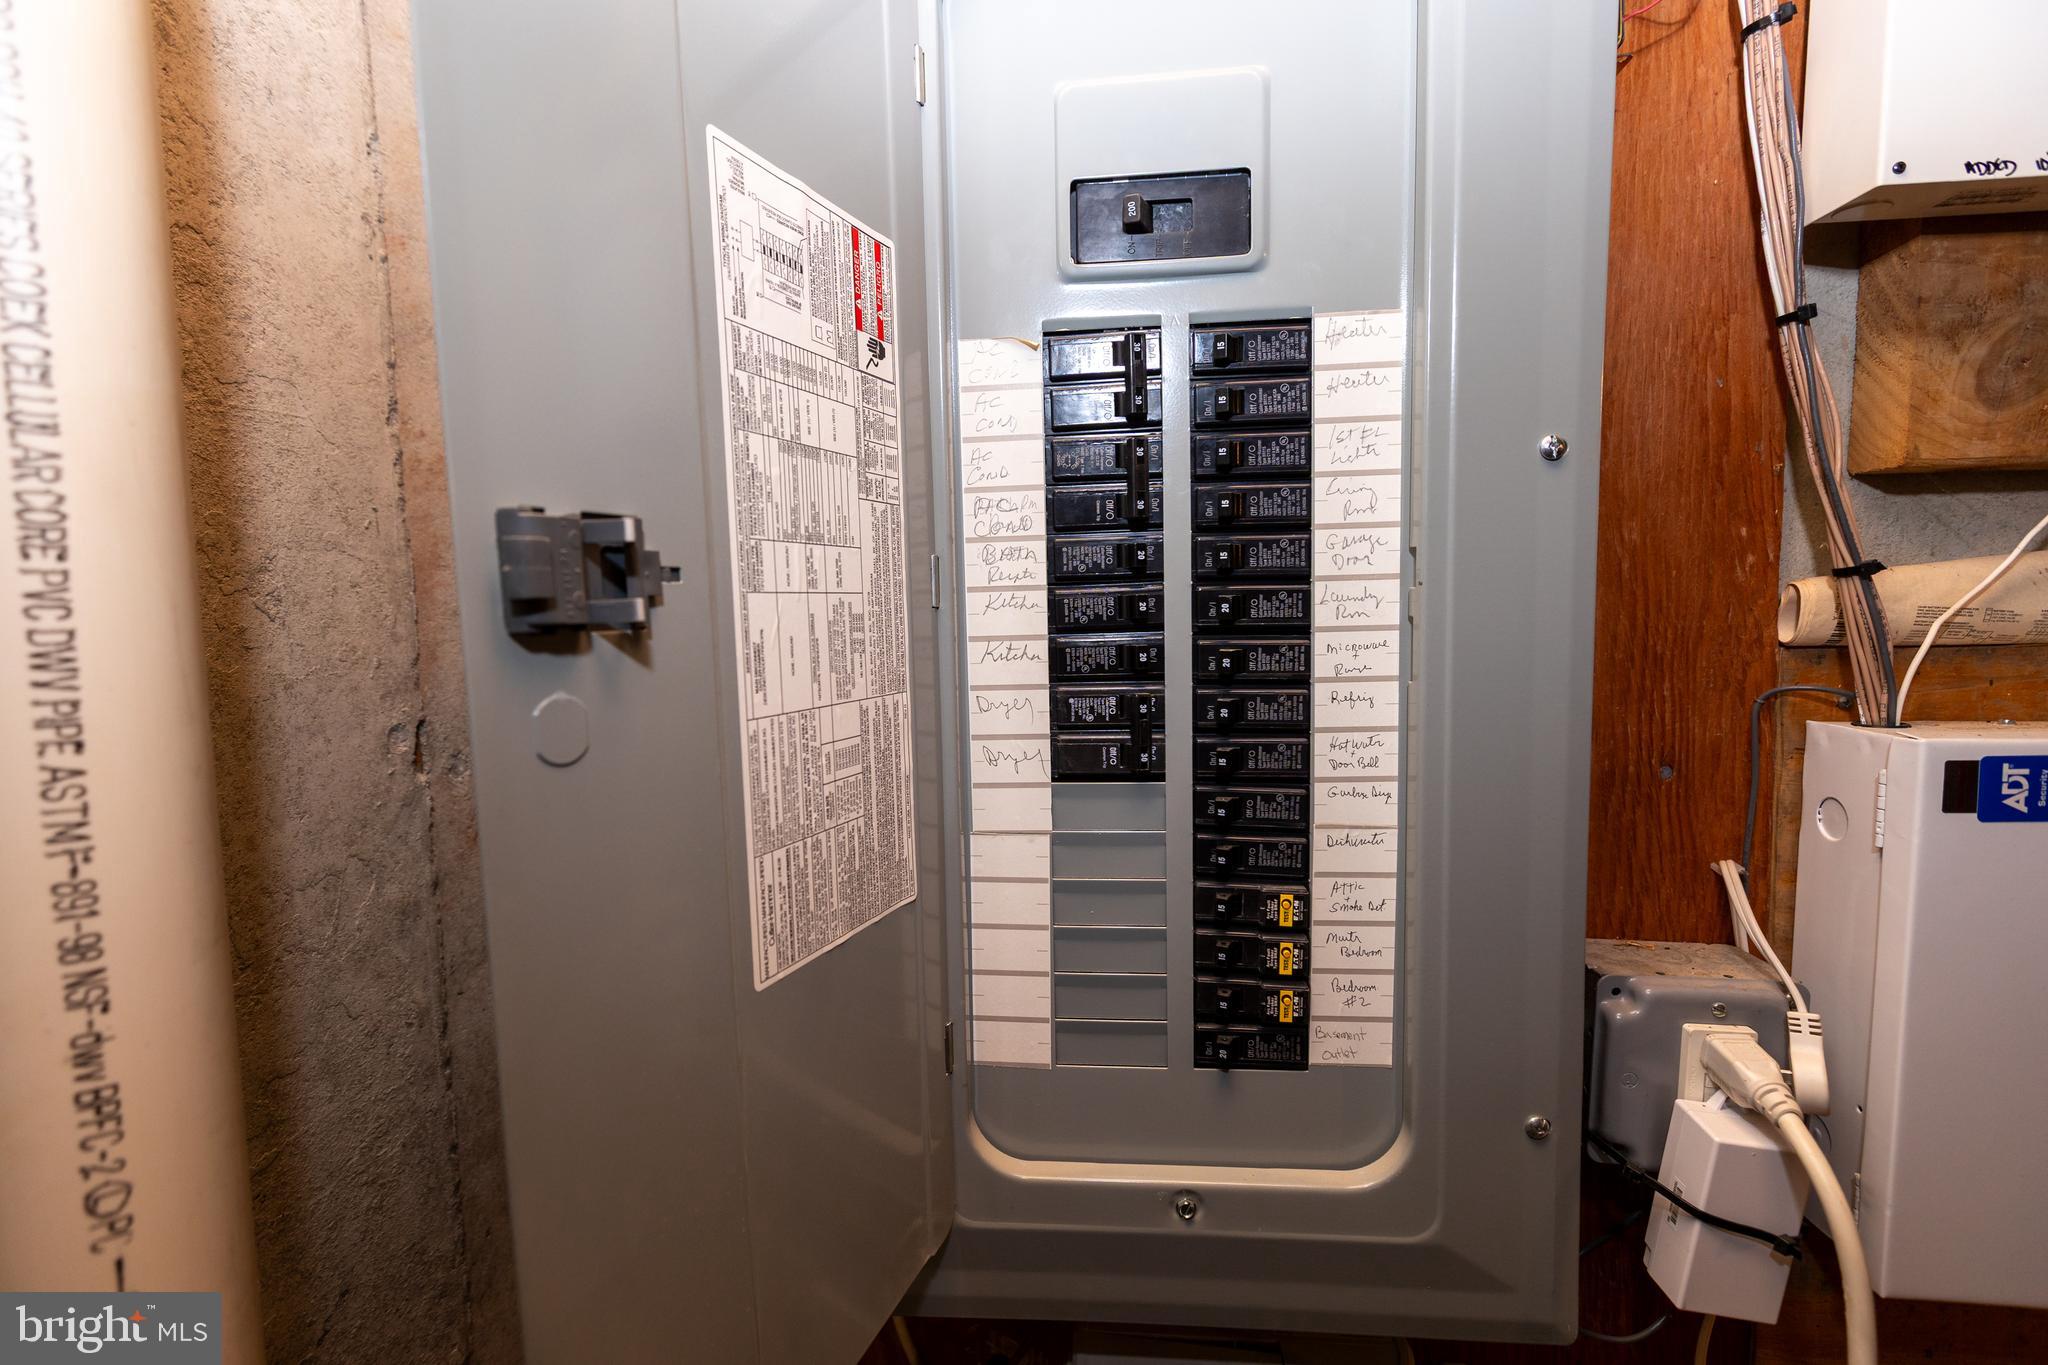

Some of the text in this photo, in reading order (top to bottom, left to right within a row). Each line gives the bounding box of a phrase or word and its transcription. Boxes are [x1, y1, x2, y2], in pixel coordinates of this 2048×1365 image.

[1128, 201, 1136, 216] 200
[1134, 342, 1141, 352] 30
[1217, 341, 1225, 350] 15
[1135, 395, 1142, 405] 30
[1218, 395, 1227, 404] 15
[2, 341, 63, 483] CELLULAR
[1136, 446, 1144, 457] 30
[1218, 447, 1227, 456] 15
[1137, 499, 1145, 510] 30
[1221, 499, 1229, 508] 15
[13, 488, 70, 562] CORE
[1137, 550, 1145, 560] 20
[1219, 551, 1228, 560] 15
[18, 566, 75, 622] PVC
[1139, 602, 1147, 612] 20
[1221, 603, 1229, 613] 20
[26, 627, 82, 692] DWV
[1139, 652, 1147, 662] 20
[1223, 658, 1231, 668] 20
[976, 695, 1034, 724] Dryer
[1139, 704, 1147, 713] 30
[1220, 708, 1229, 718] 20
[29, 697, 84, 758] PIPE
[1140, 752, 1148, 762] 30
[1219, 758, 1227, 766] 15
[982, 745, 1050, 780] Dryer
[2001, 763, 2030, 813] ADT
[38, 764, 93, 846] ASTM
[1218, 904, 1226, 912] 15
[1218, 953, 1226, 961] 15
[1220, 1001, 1228, 1009] 15
[1219, 1050, 1227, 1059] 20
